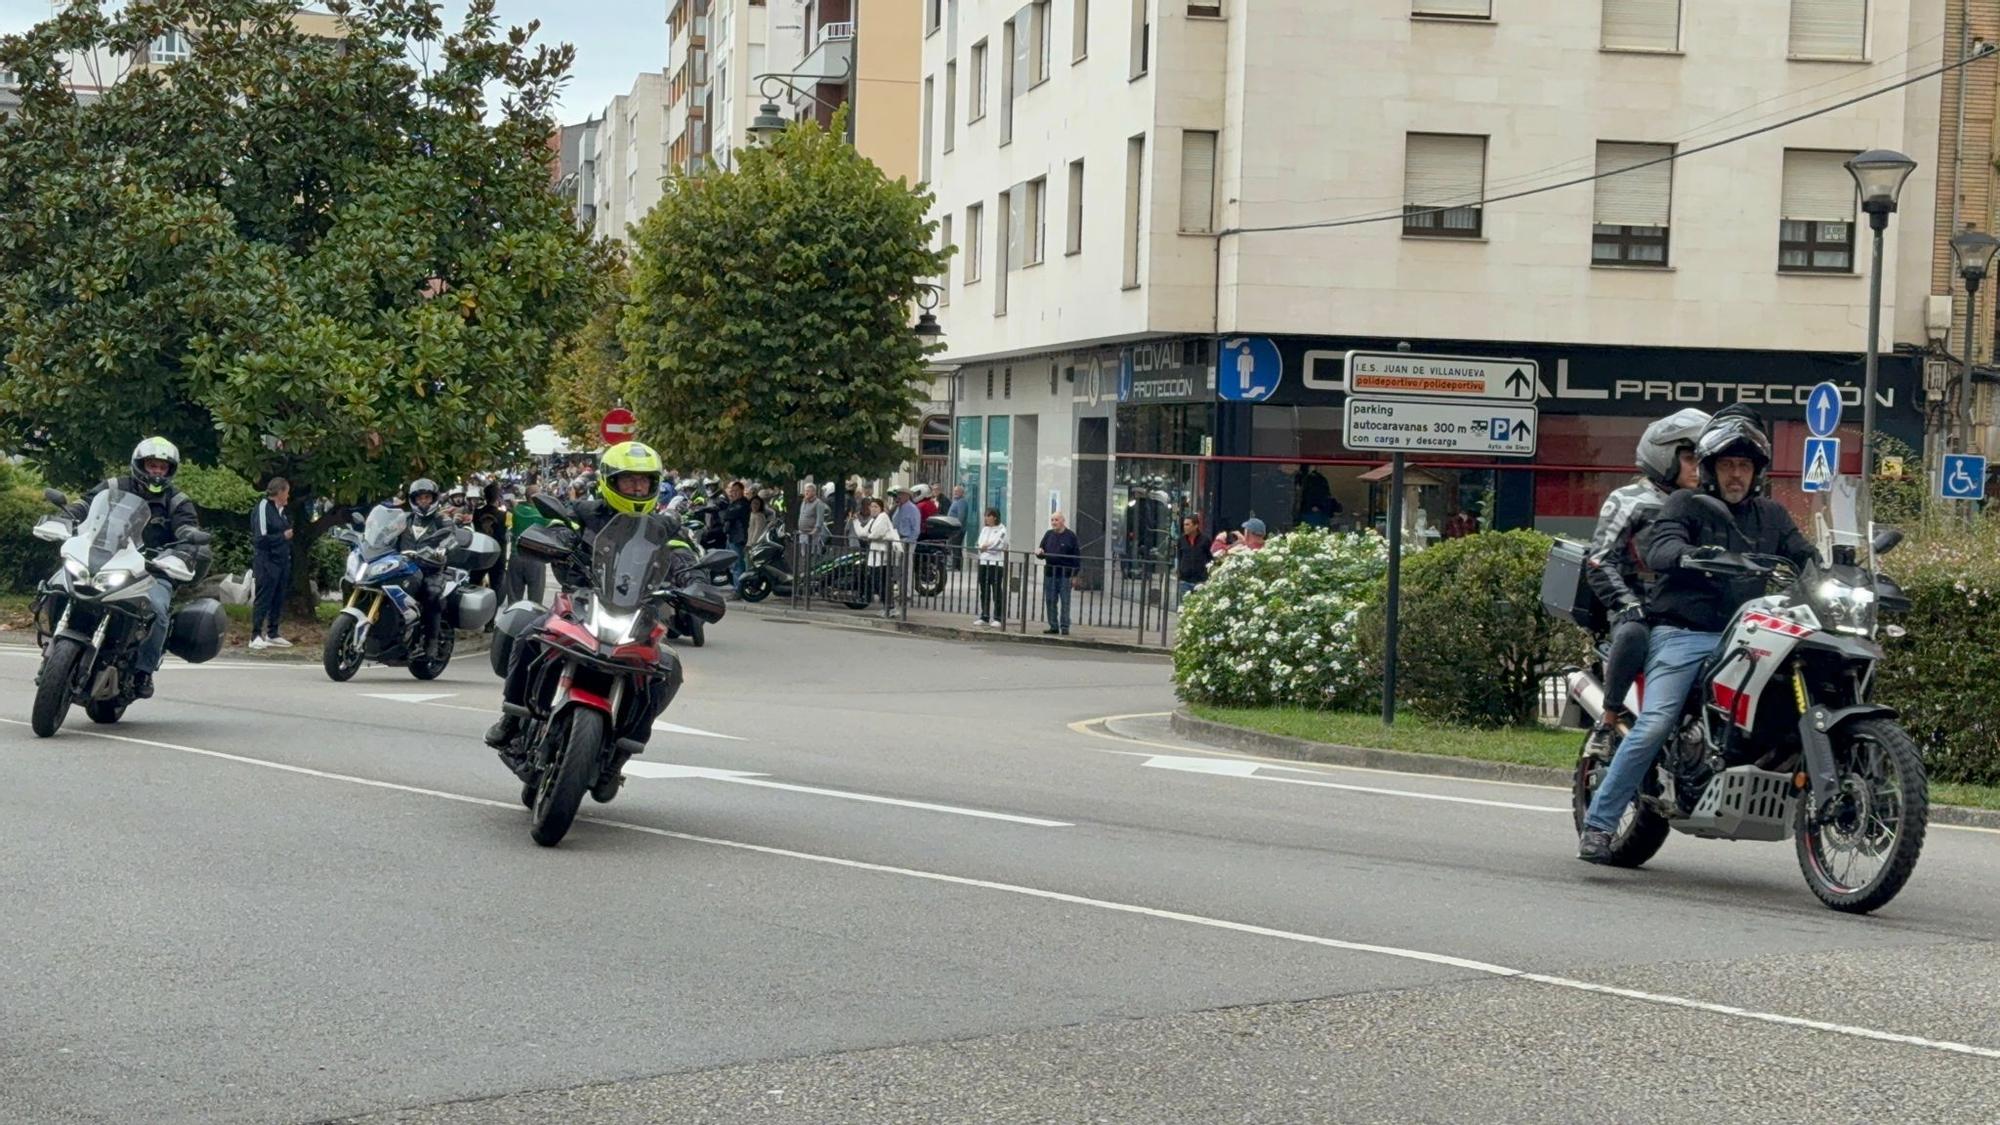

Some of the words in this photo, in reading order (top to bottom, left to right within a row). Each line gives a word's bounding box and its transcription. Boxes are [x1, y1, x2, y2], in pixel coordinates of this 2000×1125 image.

[1134, 342, 1181, 371] COVAL
[1384, 364, 1408, 373] JUAN
[1413, 366, 1424, 375] DE
[1430, 367, 1485, 376] VILLANUEVA
[1133, 375, 1192, 397] PROTECCIÓN
[1615, 380, 1894, 408] PROTECCÓN
[1353, 405, 1394, 417] parking
[1353, 420, 1428, 433] autocaravanas
[1434, 422, 1455, 433] 300
[1375, 436, 1400, 445] carga
[1405, 437, 1411, 445] y
[1416, 436, 1457, 447] descarga
